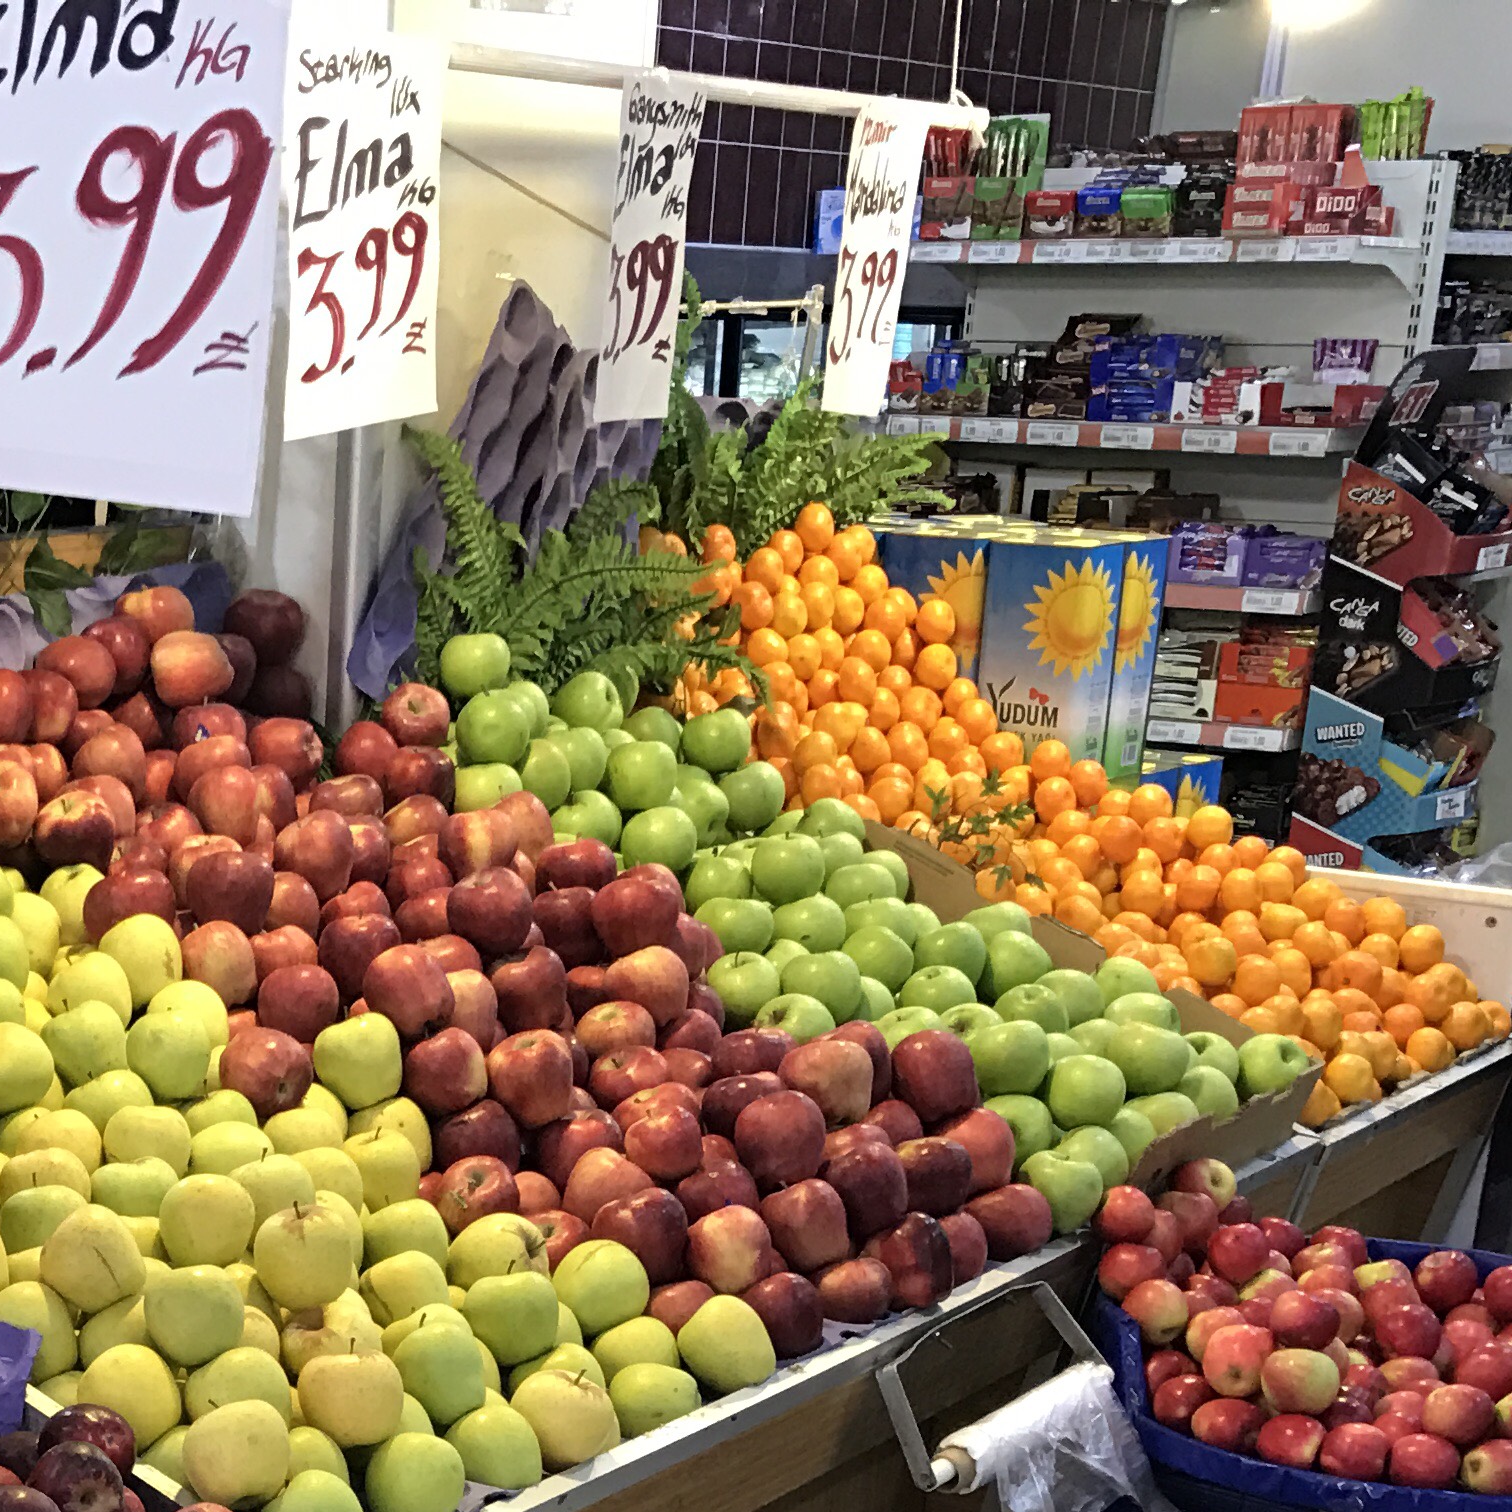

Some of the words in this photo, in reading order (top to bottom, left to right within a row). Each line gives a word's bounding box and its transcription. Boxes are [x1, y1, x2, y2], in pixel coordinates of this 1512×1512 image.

[293, 116, 415, 232] Elma
[612, 133, 675, 223] Elma
[297, 211, 429, 384] 3.99
[601, 233, 679, 365] 3.99
[829, 245, 899, 365] 3.99
[1330, 598, 1379, 617] CANGA
[987, 676, 1059, 728] YUDUM
[1316, 722, 1365, 741] WANTED
